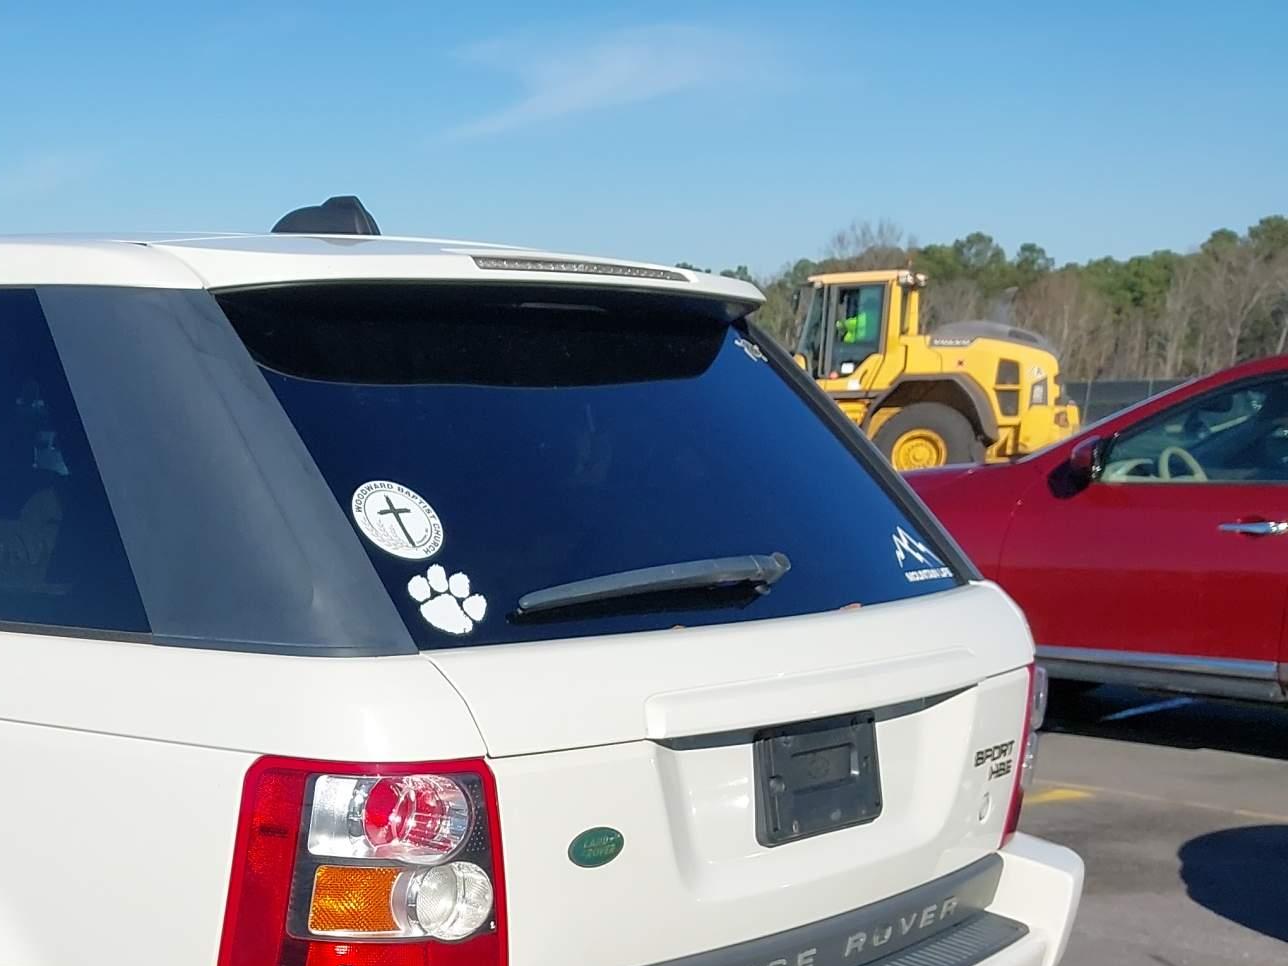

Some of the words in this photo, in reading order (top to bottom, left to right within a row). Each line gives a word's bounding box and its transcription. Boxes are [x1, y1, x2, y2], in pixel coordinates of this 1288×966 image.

[354, 482, 394, 513] WOODWARD
[397, 486, 437, 521] BAPTIST
[423, 523, 441, 555] CHURCH
[974, 739, 1015, 767] SPORT
[844, 895, 958, 958] ROVER
